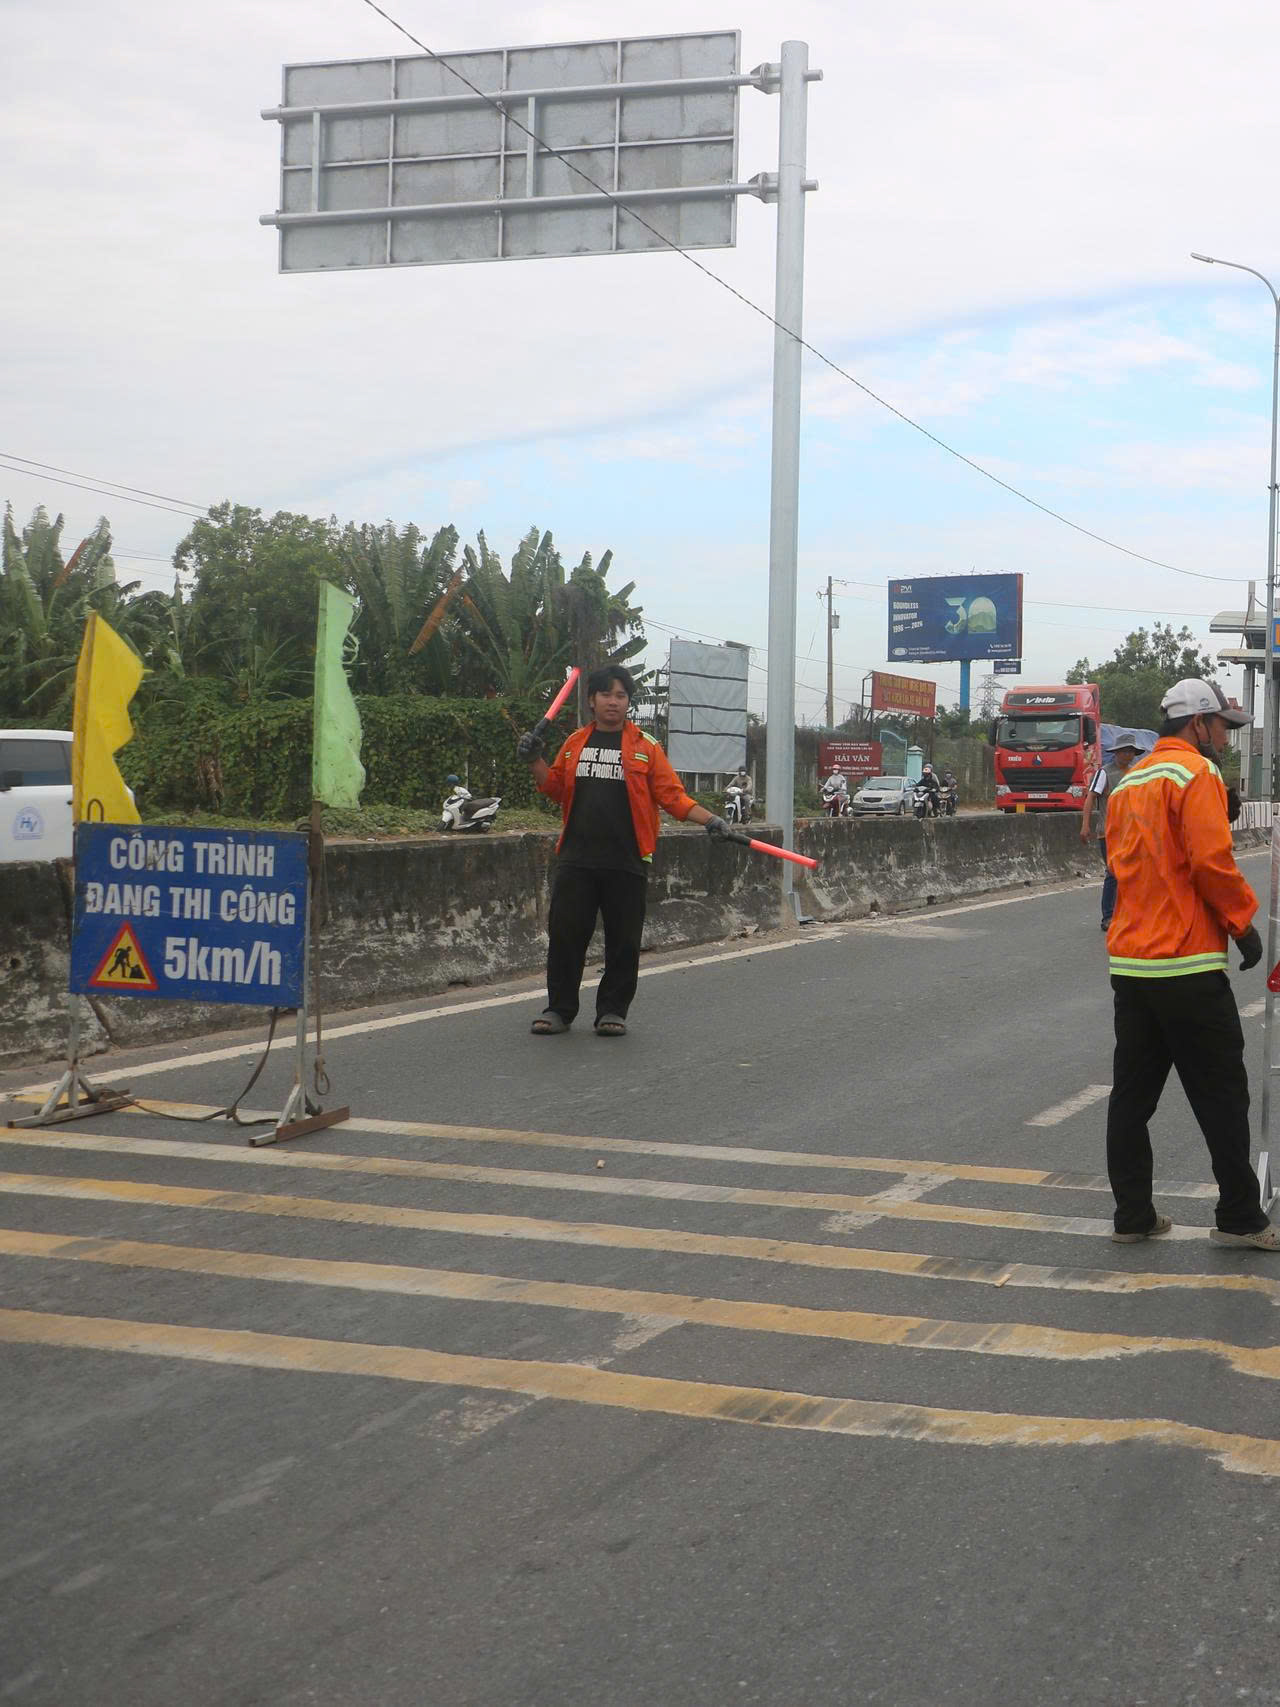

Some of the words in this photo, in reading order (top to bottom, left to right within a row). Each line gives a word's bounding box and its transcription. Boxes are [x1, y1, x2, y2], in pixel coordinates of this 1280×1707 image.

[110, 834, 184, 872] CÔNG
[193, 837, 275, 878] TRÌNH
[85, 882, 160, 917] ĐANG
[170, 886, 210, 920] THI
[220, 884, 296, 925] CÔNG
[164, 936, 282, 986] 5km/h
